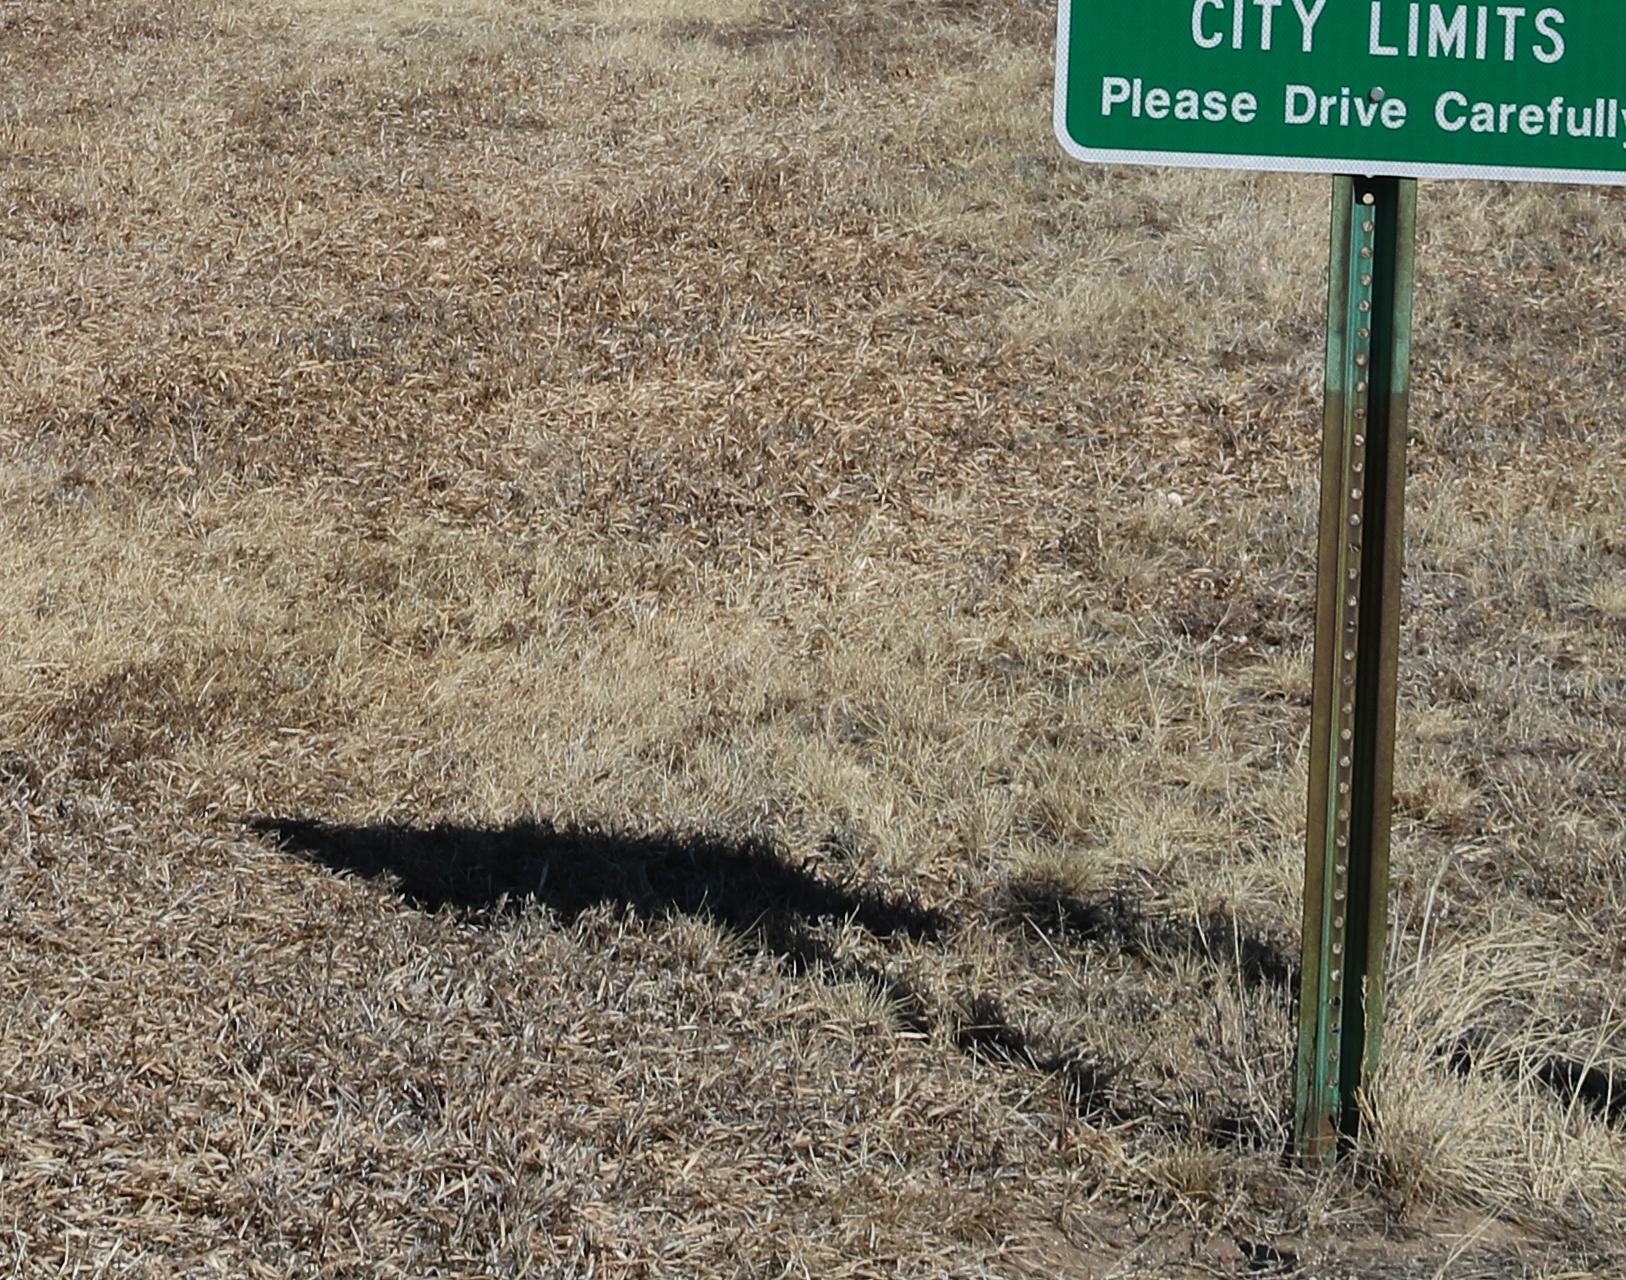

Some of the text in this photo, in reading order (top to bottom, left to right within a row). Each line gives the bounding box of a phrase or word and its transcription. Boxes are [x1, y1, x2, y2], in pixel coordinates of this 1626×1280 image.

[1368, 0, 1567, 65] LIMITS
[1100, 76, 1259, 123] Please
[1283, 84, 1408, 130] Drive
